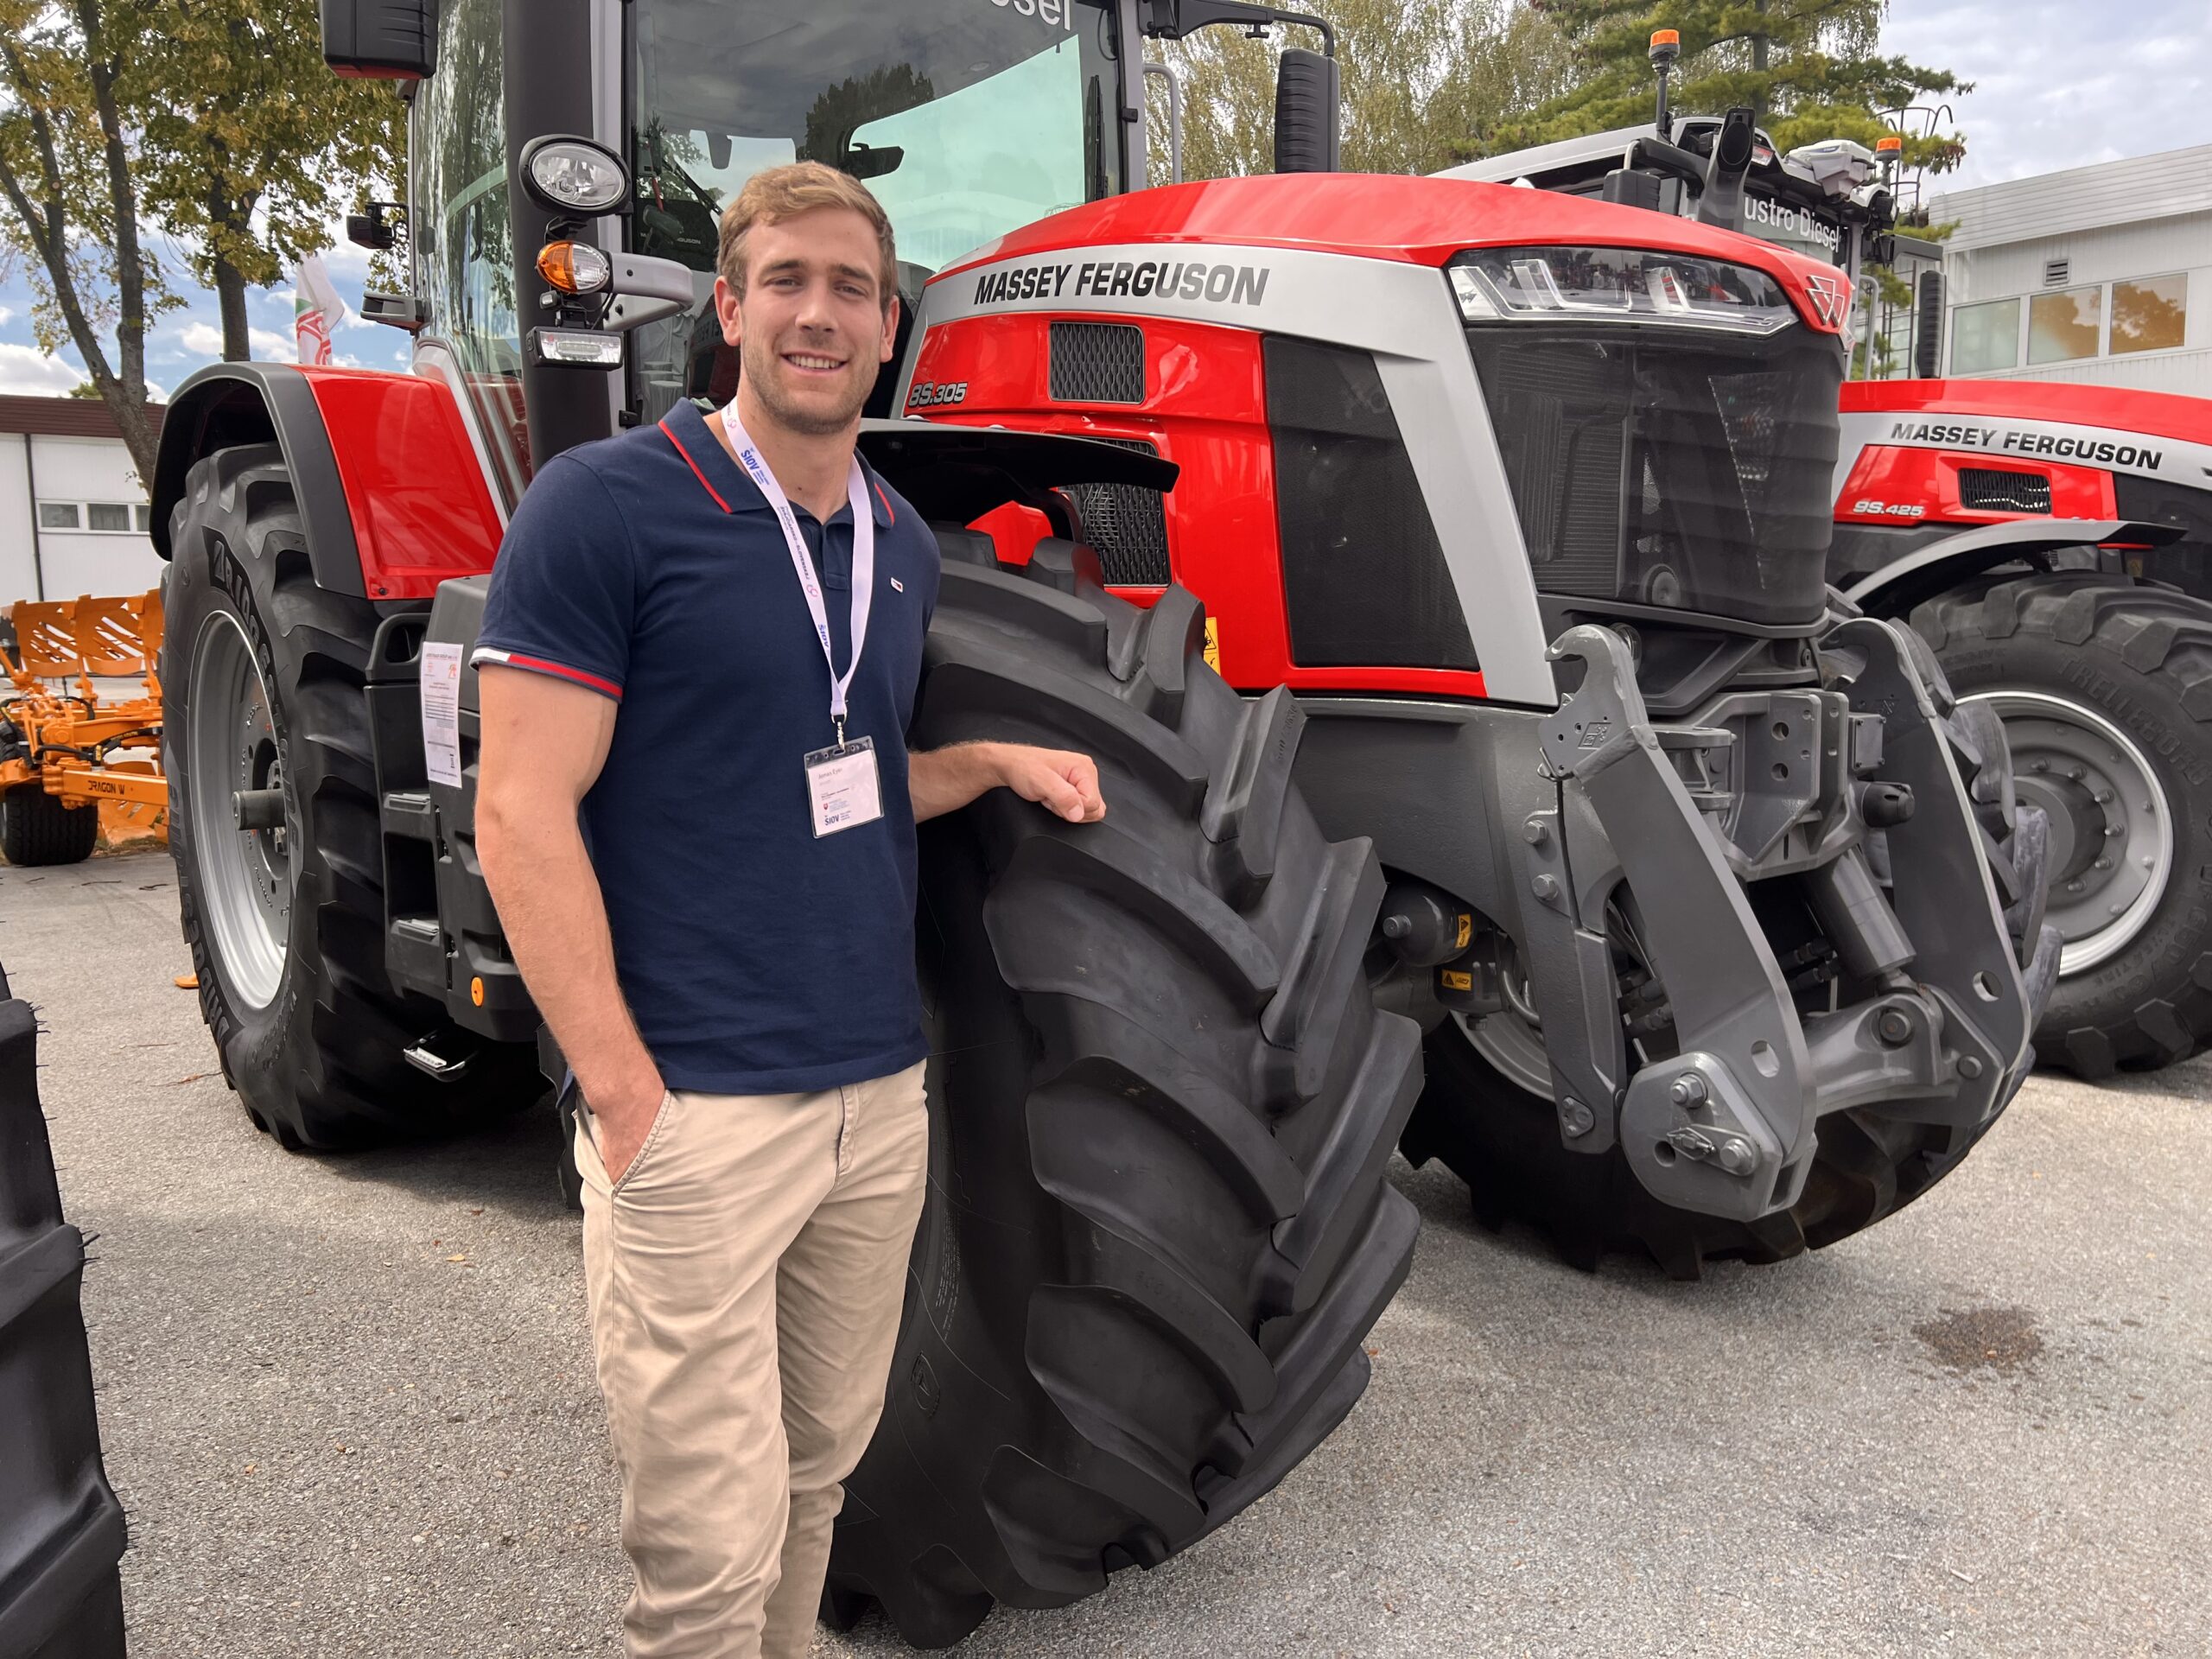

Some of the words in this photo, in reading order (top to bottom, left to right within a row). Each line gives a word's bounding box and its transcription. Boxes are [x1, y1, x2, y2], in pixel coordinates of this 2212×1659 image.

[990, 0, 1071, 31] sel
[1744, 197, 1795, 232] ustro
[1800, 207, 1840, 253] Diesel
[974, 264, 1072, 305] MASSEY
[1075, 262, 1270, 306] FERGUSON
[908, 381, 968, 408] 8S.305
[1891, 423, 1998, 447] MASSEY
[2003, 431, 2163, 470] FERGUSON
[1853, 500, 1925, 517] 9S.425
[2056, 650, 2212, 786] TRELLEBORG
[88, 779, 117, 793] DRAGON
